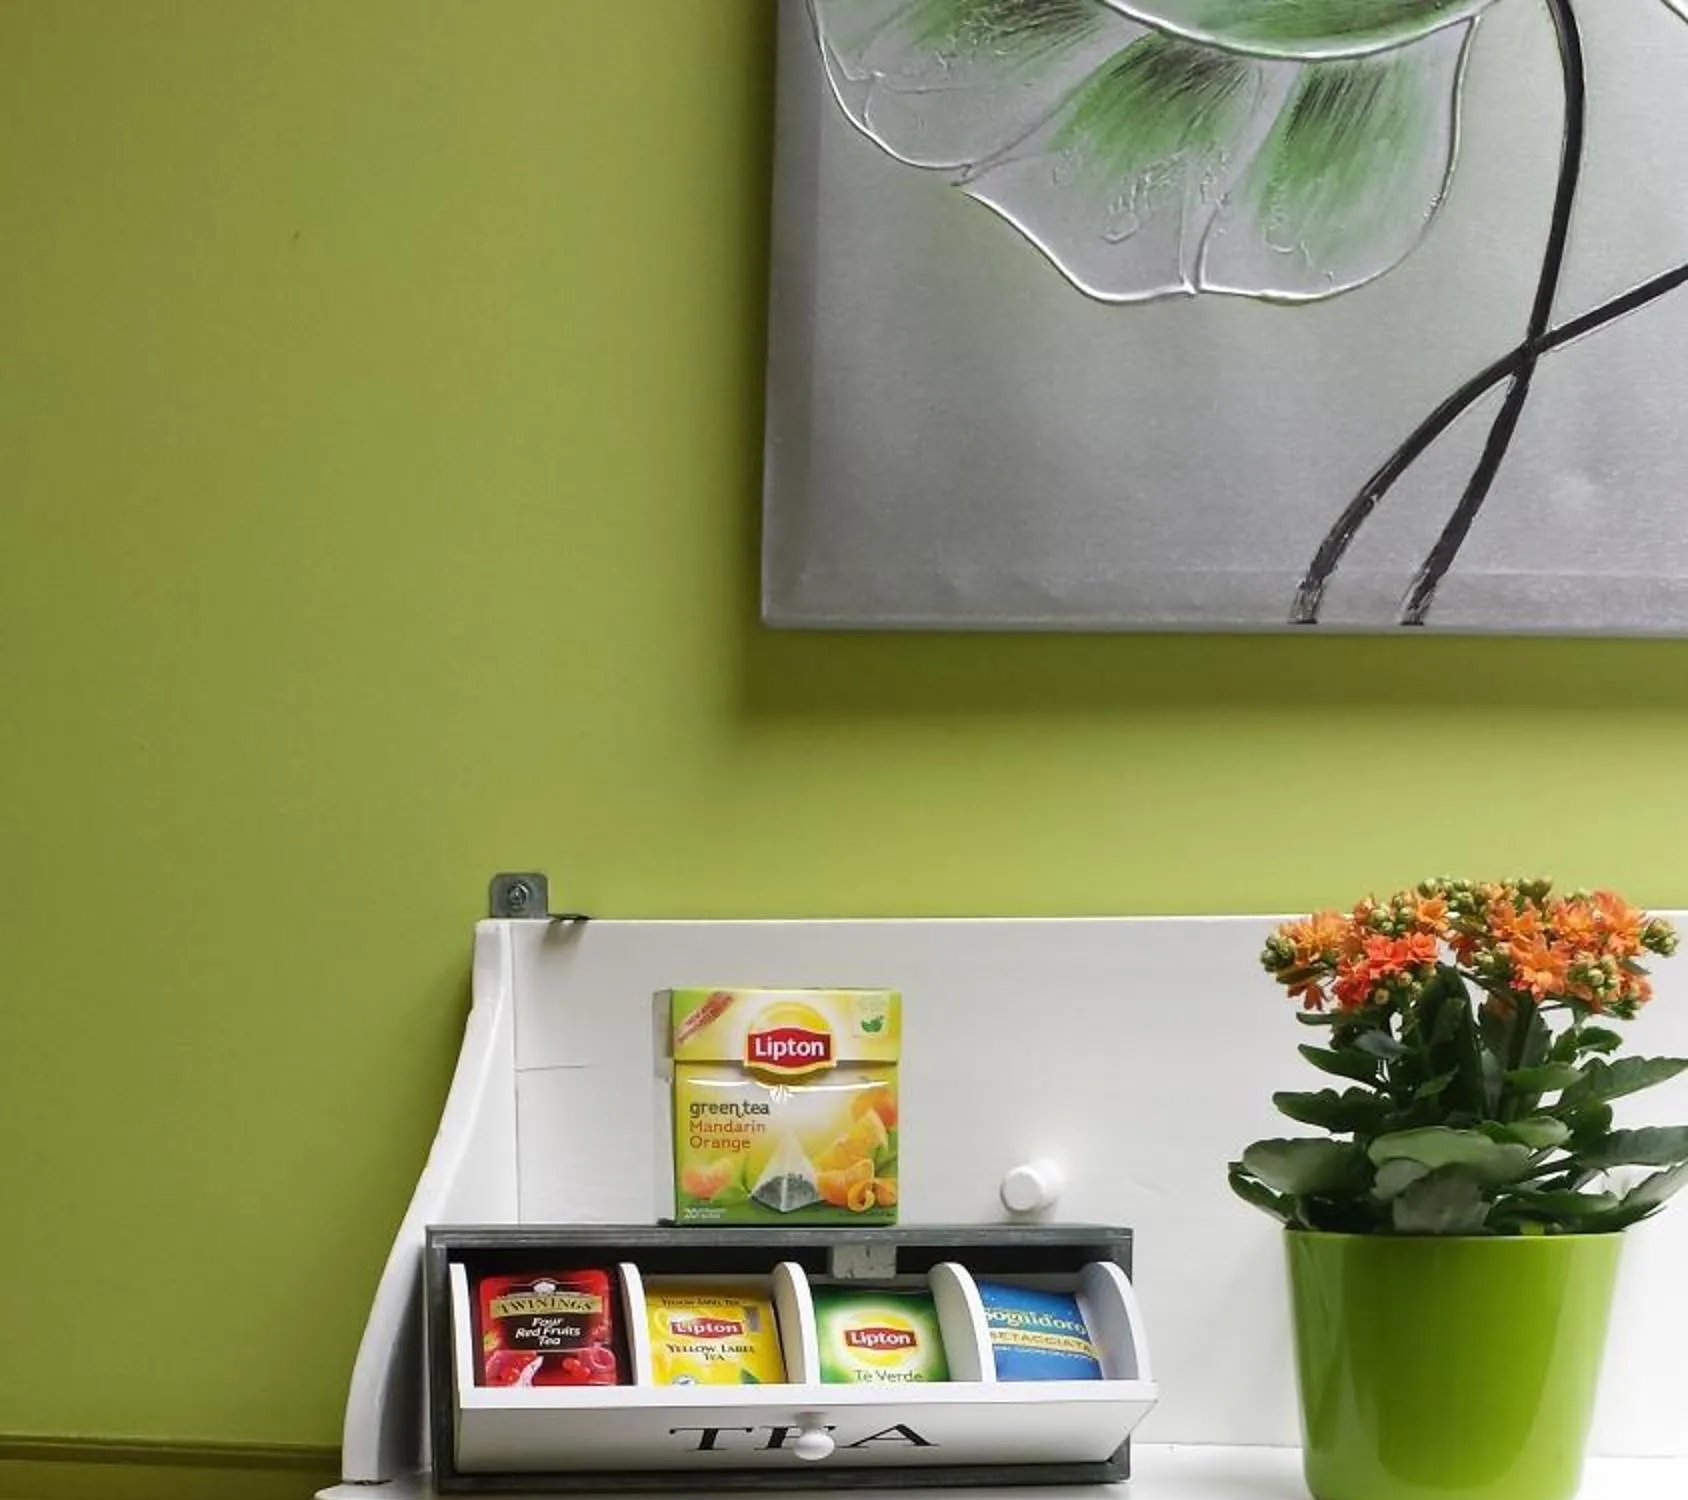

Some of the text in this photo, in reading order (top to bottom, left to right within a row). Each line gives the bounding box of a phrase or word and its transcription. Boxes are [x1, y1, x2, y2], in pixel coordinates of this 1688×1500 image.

[755, 1036, 825, 1060] Lipton
[689, 1100, 769, 1118] green tea
[689, 1119, 766, 1133] Mandarin
[689, 1135, 752, 1152] Orange
[497, 1297, 593, 1314] TWININGS
[531, 1317, 563, 1328] Four
[677, 1321, 738, 1335] Lipton
[515, 1325, 581, 1339] Red Fruits
[851, 1331, 911, 1347] Lipton
[539, 1335, 562, 1347] Tea
[875, 1369, 925, 1382] Verde
